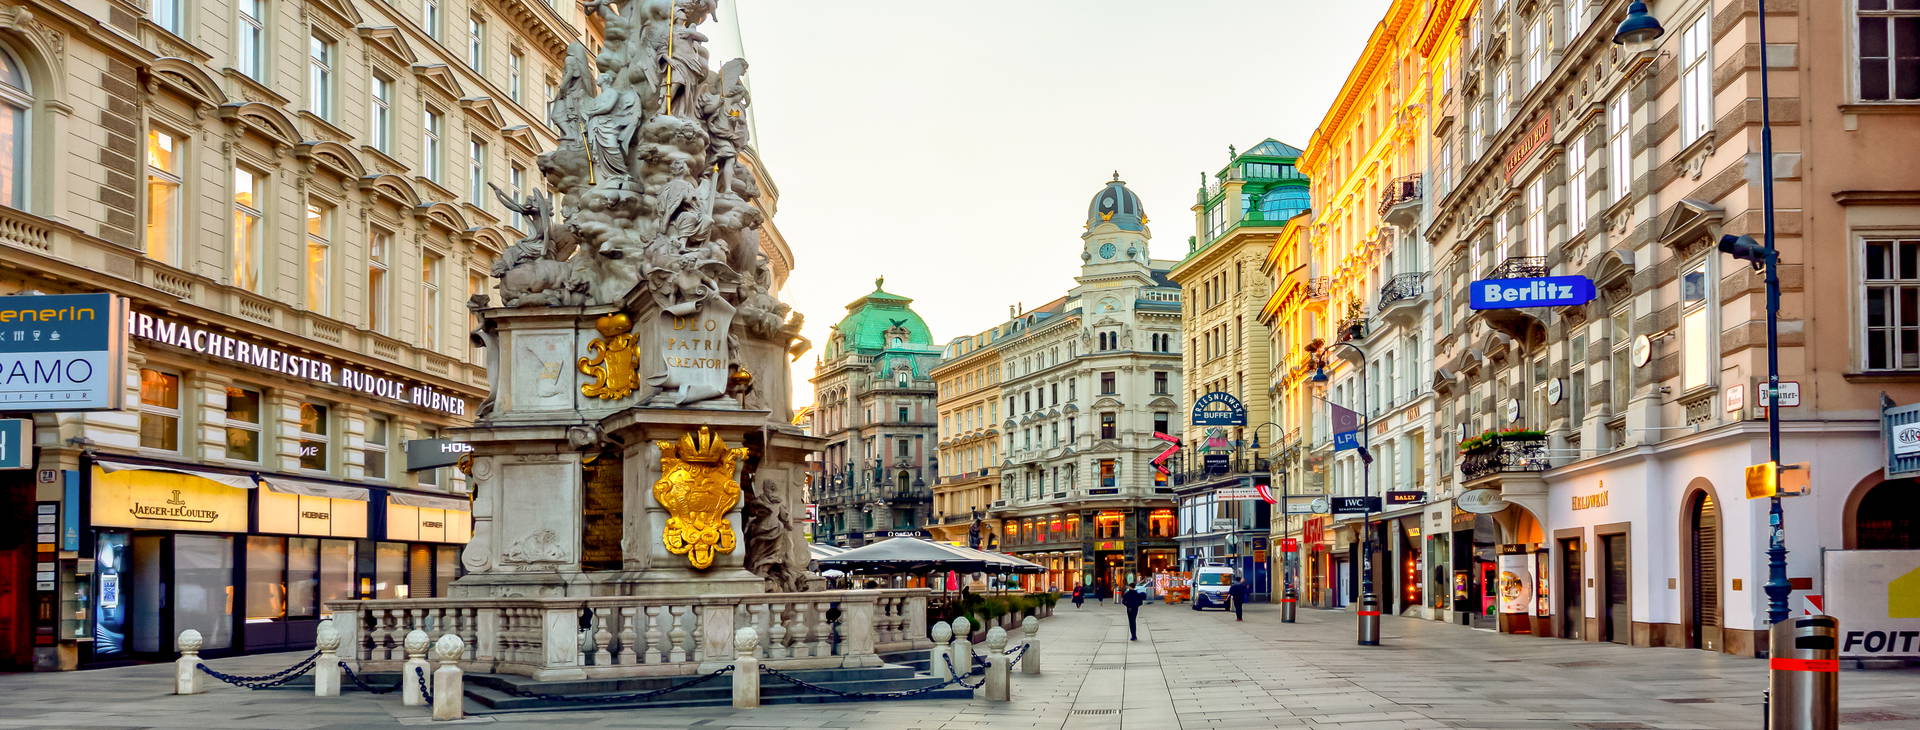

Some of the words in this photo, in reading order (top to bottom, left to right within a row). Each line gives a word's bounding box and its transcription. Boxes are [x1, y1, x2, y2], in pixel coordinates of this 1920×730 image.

[1535, 119, 1548, 143] HOF
[1484, 281, 1573, 302] Berlitz
[0, 306, 95, 322] enerin
[667, 337, 721, 351] PATRI
[0, 358, 92, 384] AMO
[128, 311, 332, 383] HRMACHERMEISTER
[342, 367, 404, 400] RUDOLF
[413, 386, 465, 416] HÜBNER
[1204, 411, 1232, 419] BUFFET
[1345, 499, 1363, 507] IWC
[1842, 630, 1920, 653] FOIT
